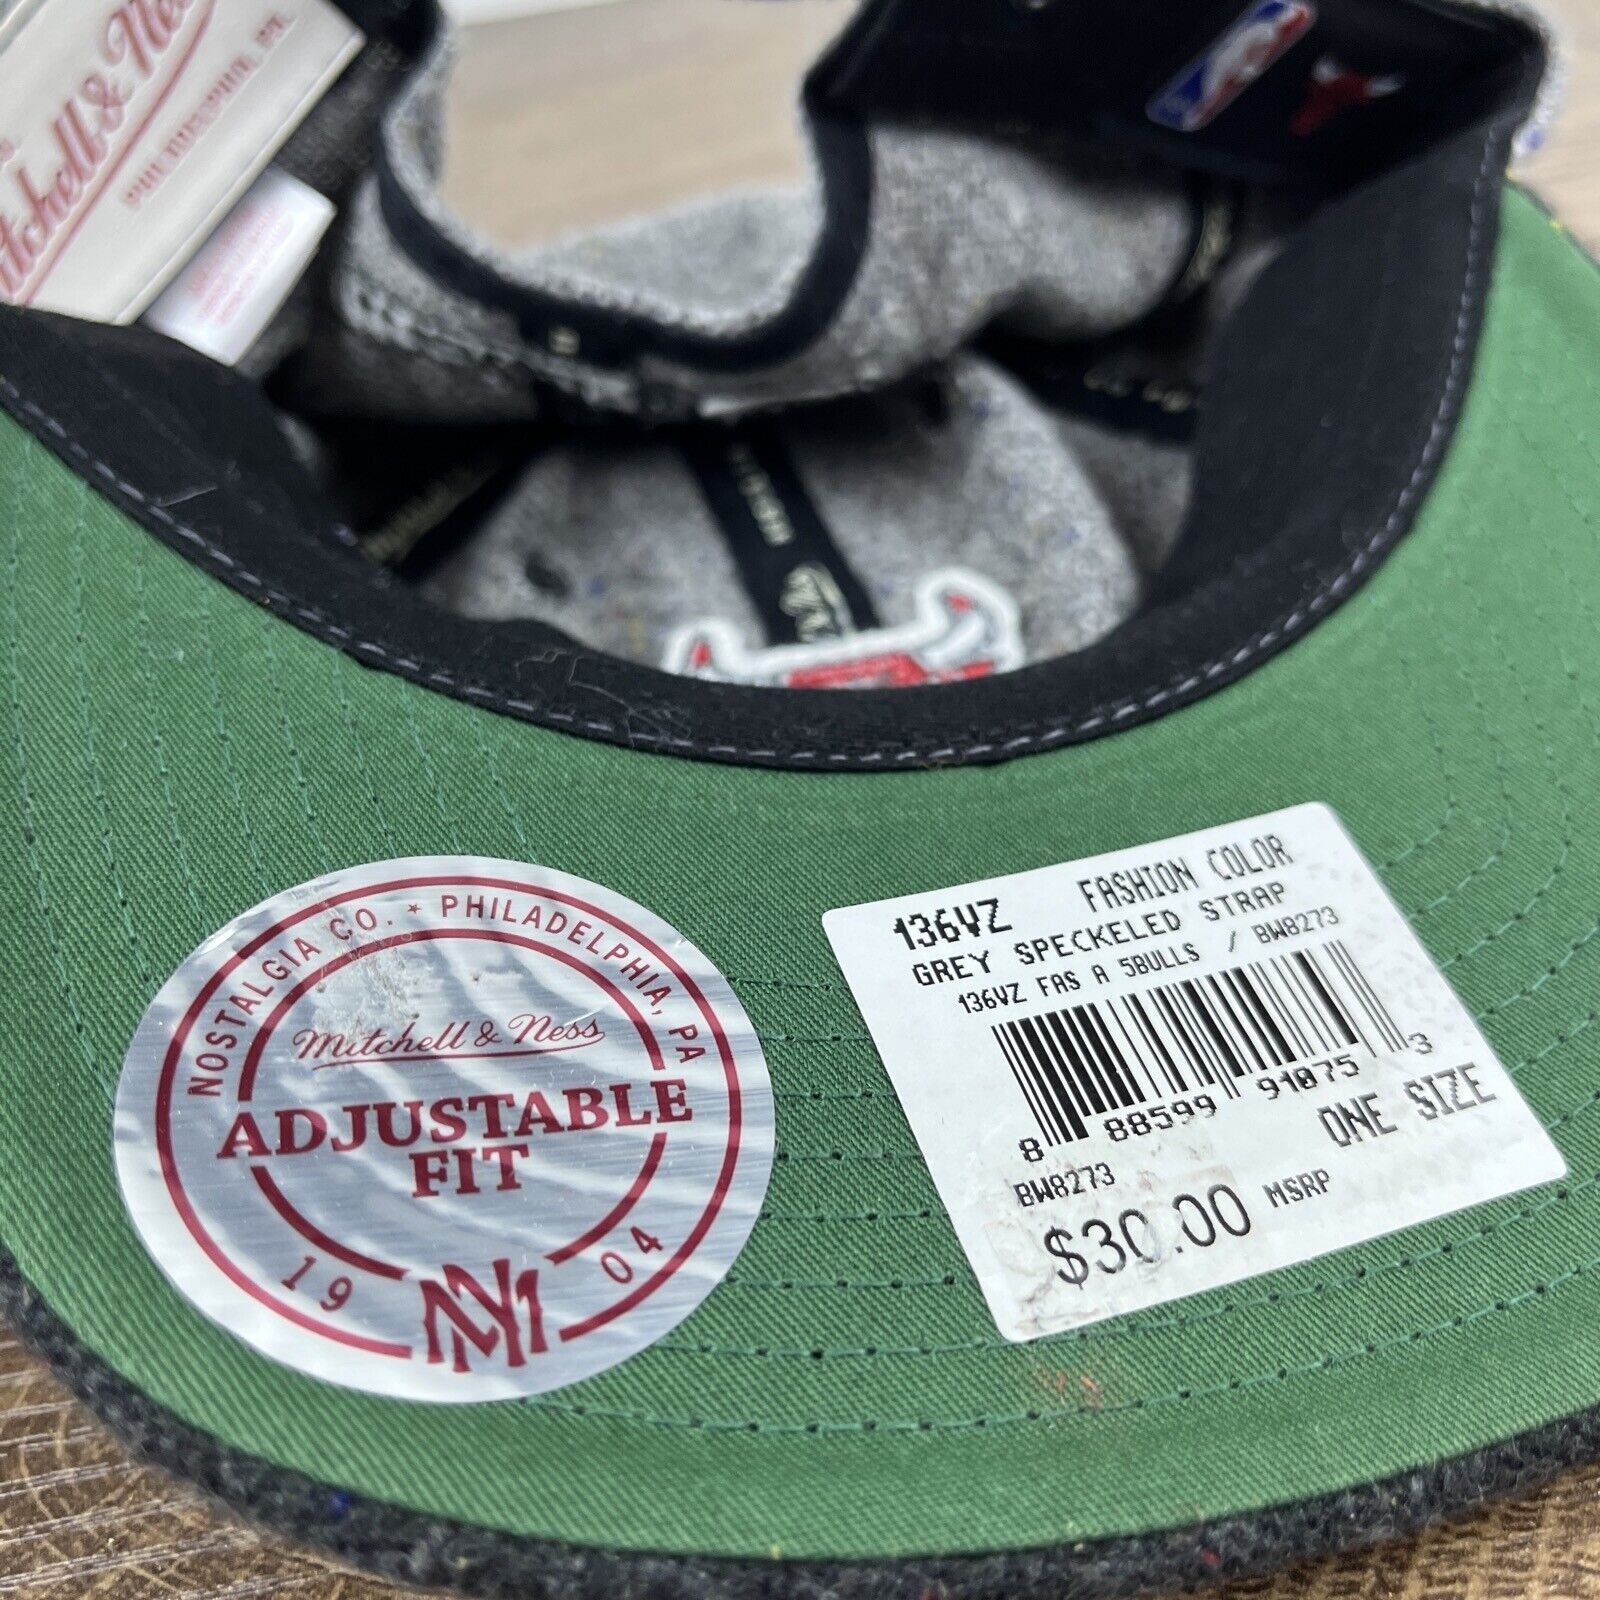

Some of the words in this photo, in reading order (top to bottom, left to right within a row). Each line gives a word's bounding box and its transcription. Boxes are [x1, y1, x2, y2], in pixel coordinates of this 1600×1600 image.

[79, 71, 133, 131] &
[1076, 856, 1200, 913] FASHION
[1206, 833, 1294, 881] COLOR
[893, 897, 1013, 951] 136VZ
[912, 949, 992, 987] GREY
[1014, 909, 1182, 965] SPECKELED
[1199, 881, 1285, 921] STRAP
[958, 982, 1028, 1013] 136VZ
[1035, 970, 1081, 997] FAS
[1091, 964, 1110, 984] A
[1117, 942, 1200, 977] 5BULLS
[1227, 930, 1236, 952] /
[1251, 905, 1339, 944] BW8273
[187, 937, 322, 1097] NOSTALGIA
[329, 908, 393, 940] CO.
[441, 894, 673, 1015] PHILADELPHIA,
[668, 1024, 706, 1063] PA
[292, 1020, 471, 1060] Mitchell
[474, 1020, 502, 1047] &
[508, 1013, 606, 1044] Ness
[216, 1078, 693, 1160] ADJUSTABLE
[1018, 1137, 1044, 1162] 8
[1103, 1094, 1217, 1142] 88599
[1256, 1053, 1360, 1100] 91075
[1407, 1032, 1433, 1055] 3
[1316, 1091, 1398, 1148] ONE
[1403, 1061, 1498, 1121] SIZE
[408, 1143, 529, 1198] FIT
[1013, 1162, 1115, 1207] BW8273
[1044, 1184, 1251, 1290] $30.00
[1262, 1168, 1330, 1208] MSRP
